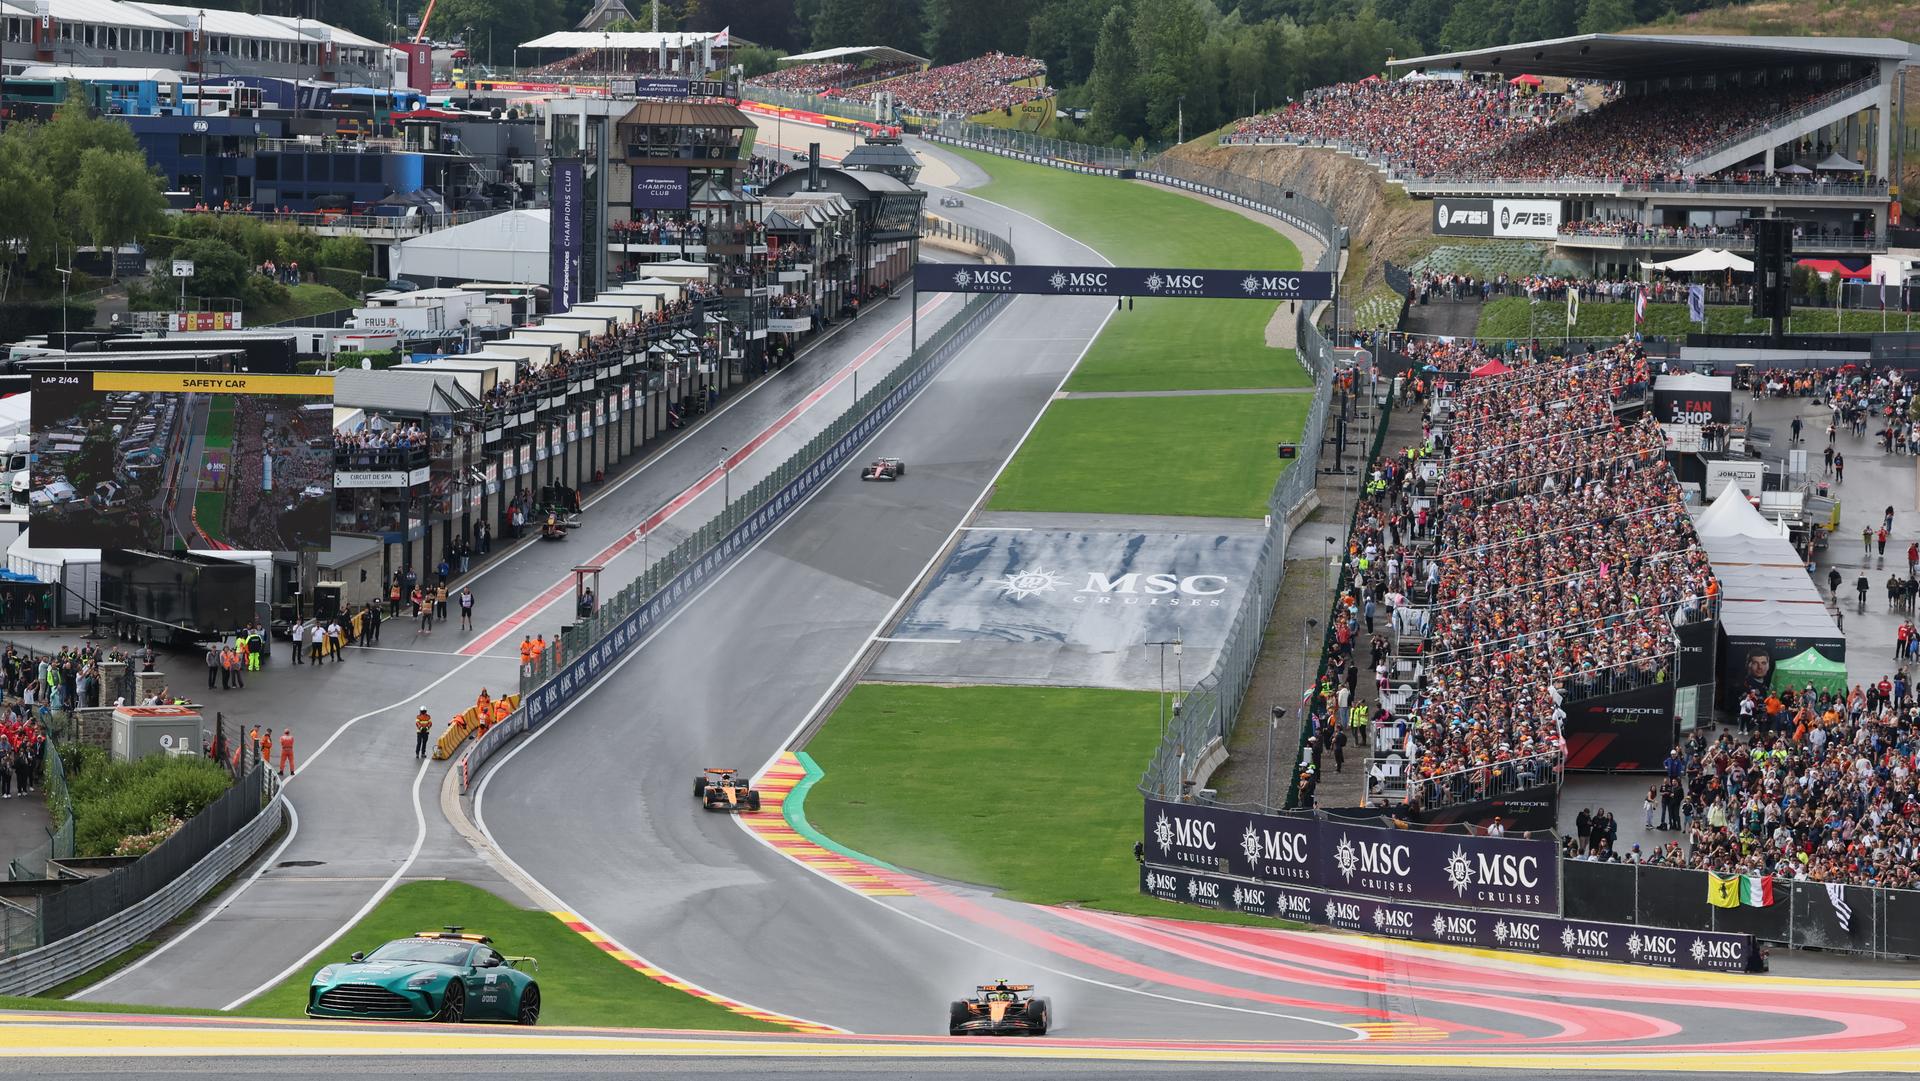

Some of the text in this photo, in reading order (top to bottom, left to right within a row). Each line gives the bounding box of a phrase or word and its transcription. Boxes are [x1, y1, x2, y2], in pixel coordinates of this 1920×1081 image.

[1532, 213, 1546, 225] 25
[974, 270, 1012, 284] MSC
[1070, 273, 1107, 287] MSC
[1166, 275, 1204, 289] MSC
[1262, 276, 1300, 290] MSC
[365, 318, 385, 326] FRUY
[182, 379, 246, 388] SAFETY CAR
[1686, 401, 1712, 412] FAN
[1678, 412, 1712, 424] SHOP
[1078, 572, 1228, 595] MSC
[1073, 596, 1221, 606] CRUISES
[1175, 817, 1216, 850] MSC
[1263, 829, 1308, 863] MSC
[1177, 852, 1219, 866] CRUISES
[1359, 841, 1410, 877] MSC
[1265, 865, 1310, 879] CRUISES
[1477, 853, 1538, 888] MSC
[1156, 873, 1176, 891] MSC
[1198, 881, 1219, 898] MSC
[1362, 878, 1412, 893] CRUISES
[1244, 888, 1265, 905] MSC
[1288, 895, 1310, 912] MSC
[1478, 891, 1540, 905] CRUISES
[1337, 902, 1360, 921] MSC
[1385, 910, 1413, 928] MSC
[1385, 928, 1413, 936] CRUISES
[1447, 917, 1476, 935] MSC
[1509, 922, 1540, 941] MSC
[1510, 941, 1540, 949] CRUISES
[1577, 930, 1608, 948] MSC
[1643, 935, 1676, 953] MSC
[1577, 948, 1608, 957] CRUISES
[1708, 941, 1742, 959] MSC
